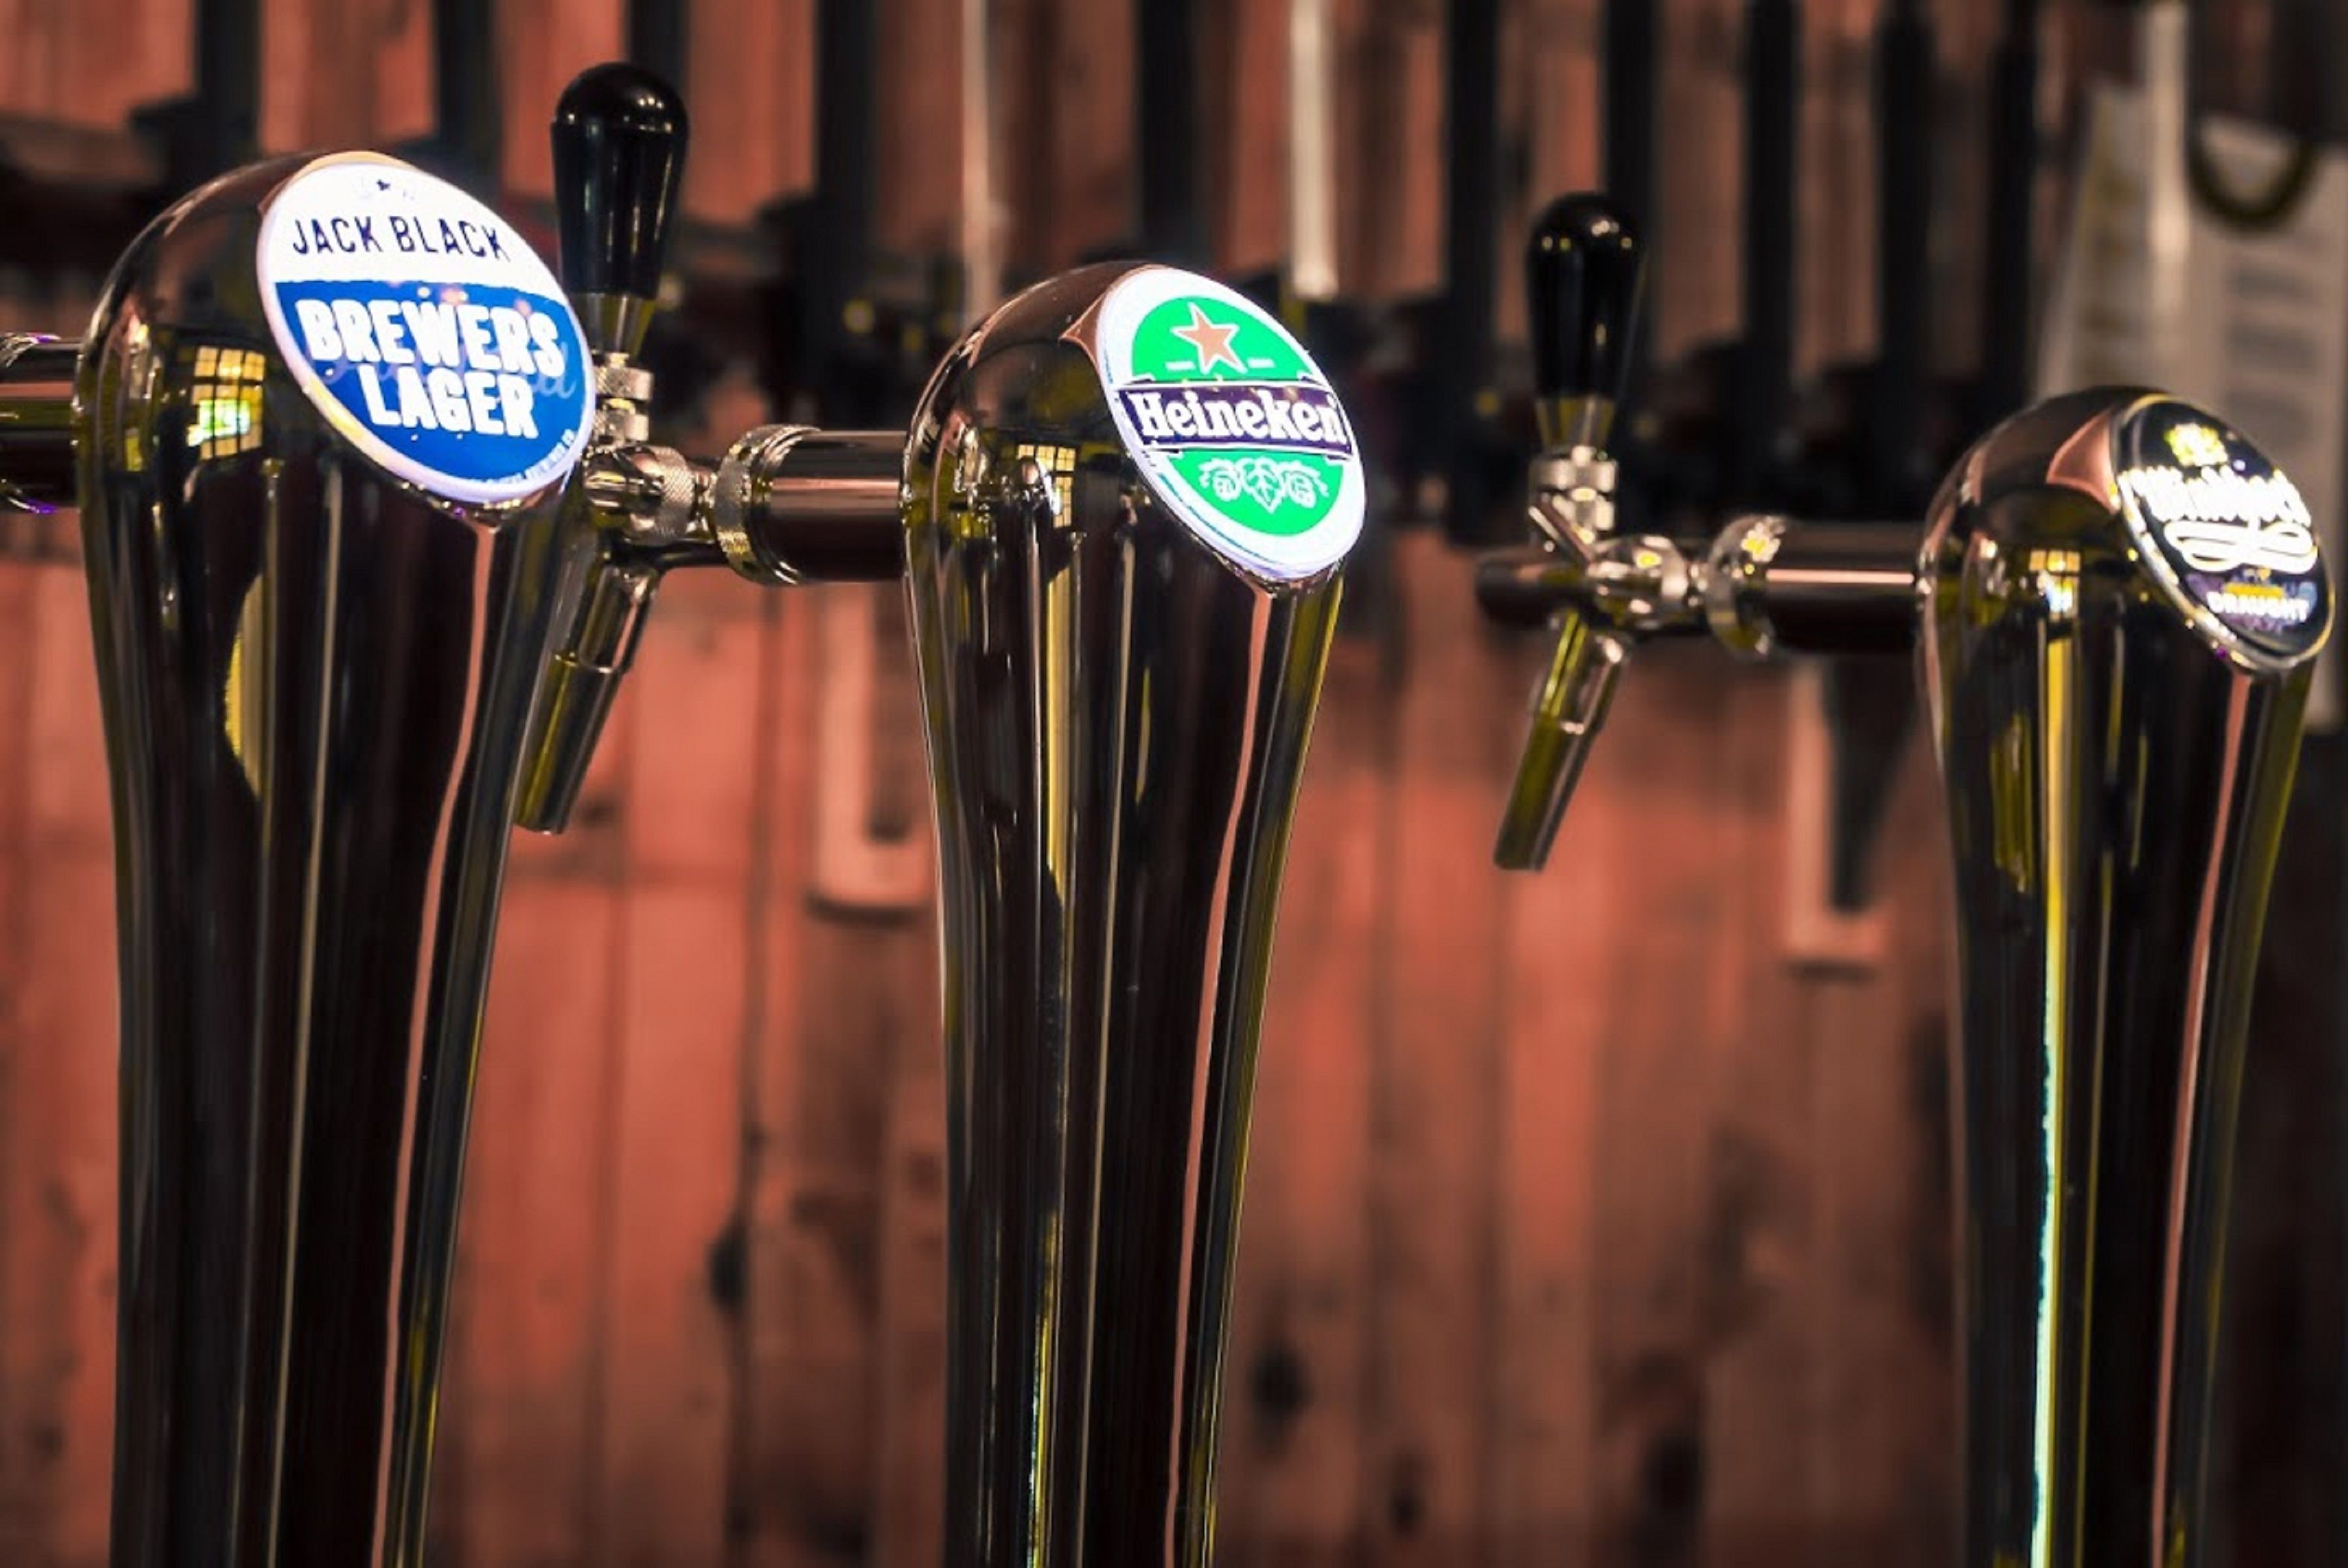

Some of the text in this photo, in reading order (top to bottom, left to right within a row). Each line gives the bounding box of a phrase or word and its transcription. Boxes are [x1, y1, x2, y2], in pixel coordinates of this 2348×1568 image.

[293, 215, 511, 262] JACK BLACK
[295, 299, 565, 378] BREWERS
[356, 365, 539, 439] LAGER
[1129, 390, 1347, 443] Heineken
